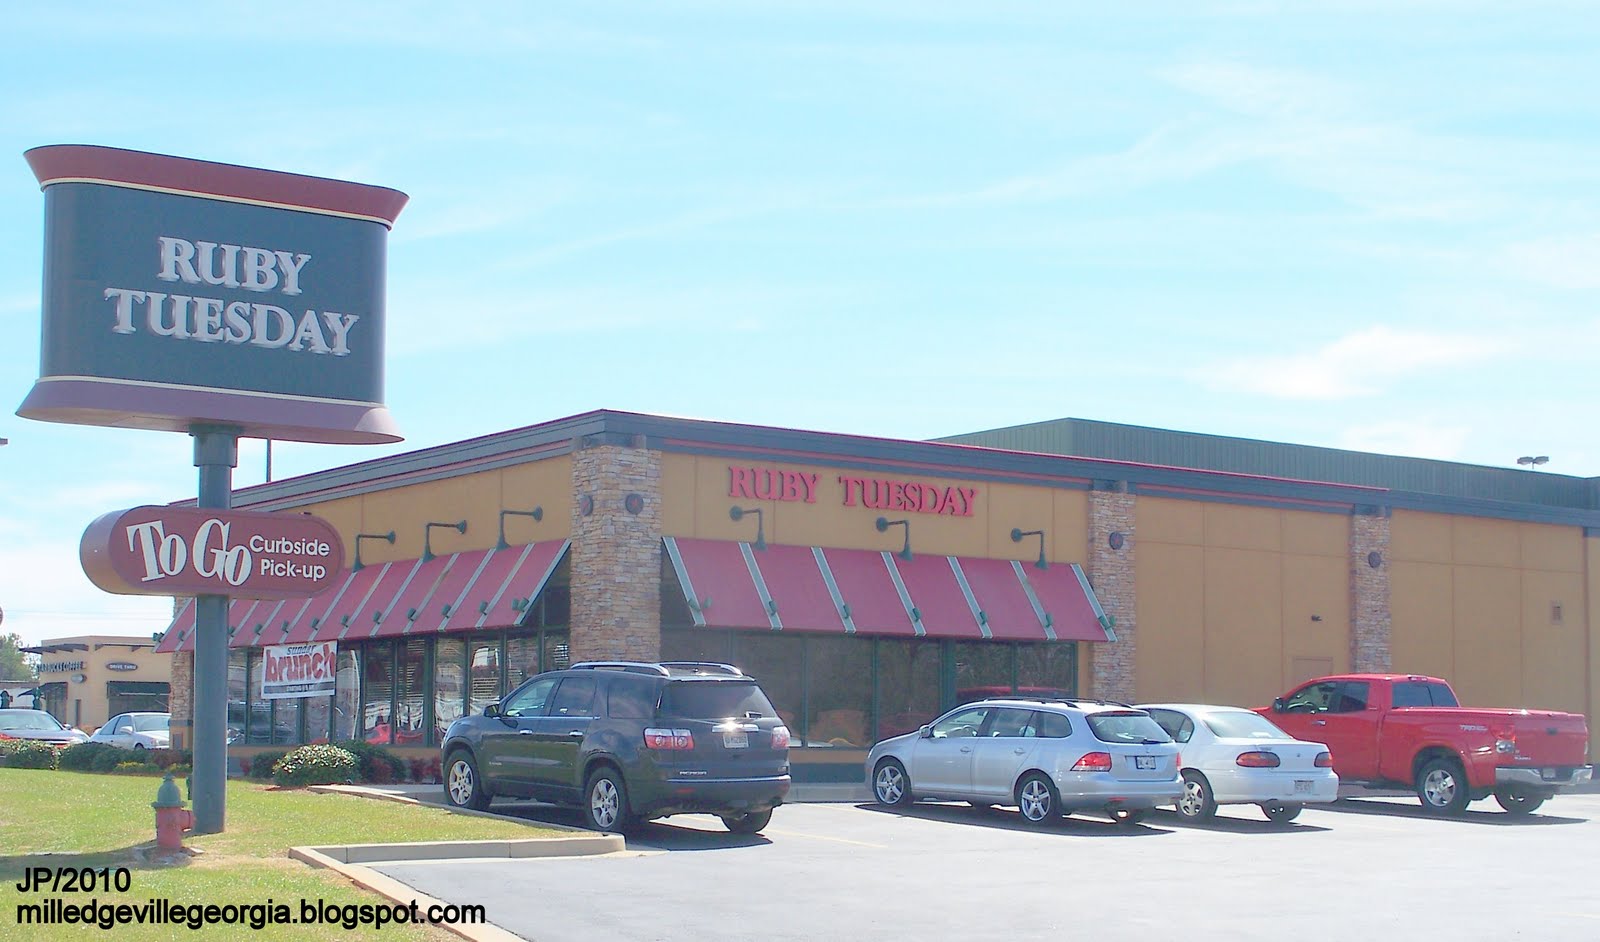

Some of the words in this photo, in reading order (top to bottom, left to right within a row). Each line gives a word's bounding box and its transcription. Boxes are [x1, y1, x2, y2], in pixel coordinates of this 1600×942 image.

[157, 236, 311, 296] RUBY
[104, 288, 360, 356] TUESDAY
[728, 466, 821, 504] RUBY
[838, 476, 979, 516] TUESDAY
[126, 519, 188, 583] To
[192, 518, 253, 586] Go
[249, 534, 331, 557] Curbside
[260, 558, 327, 582] Pick-up
[265, 644, 336, 682] brunch
